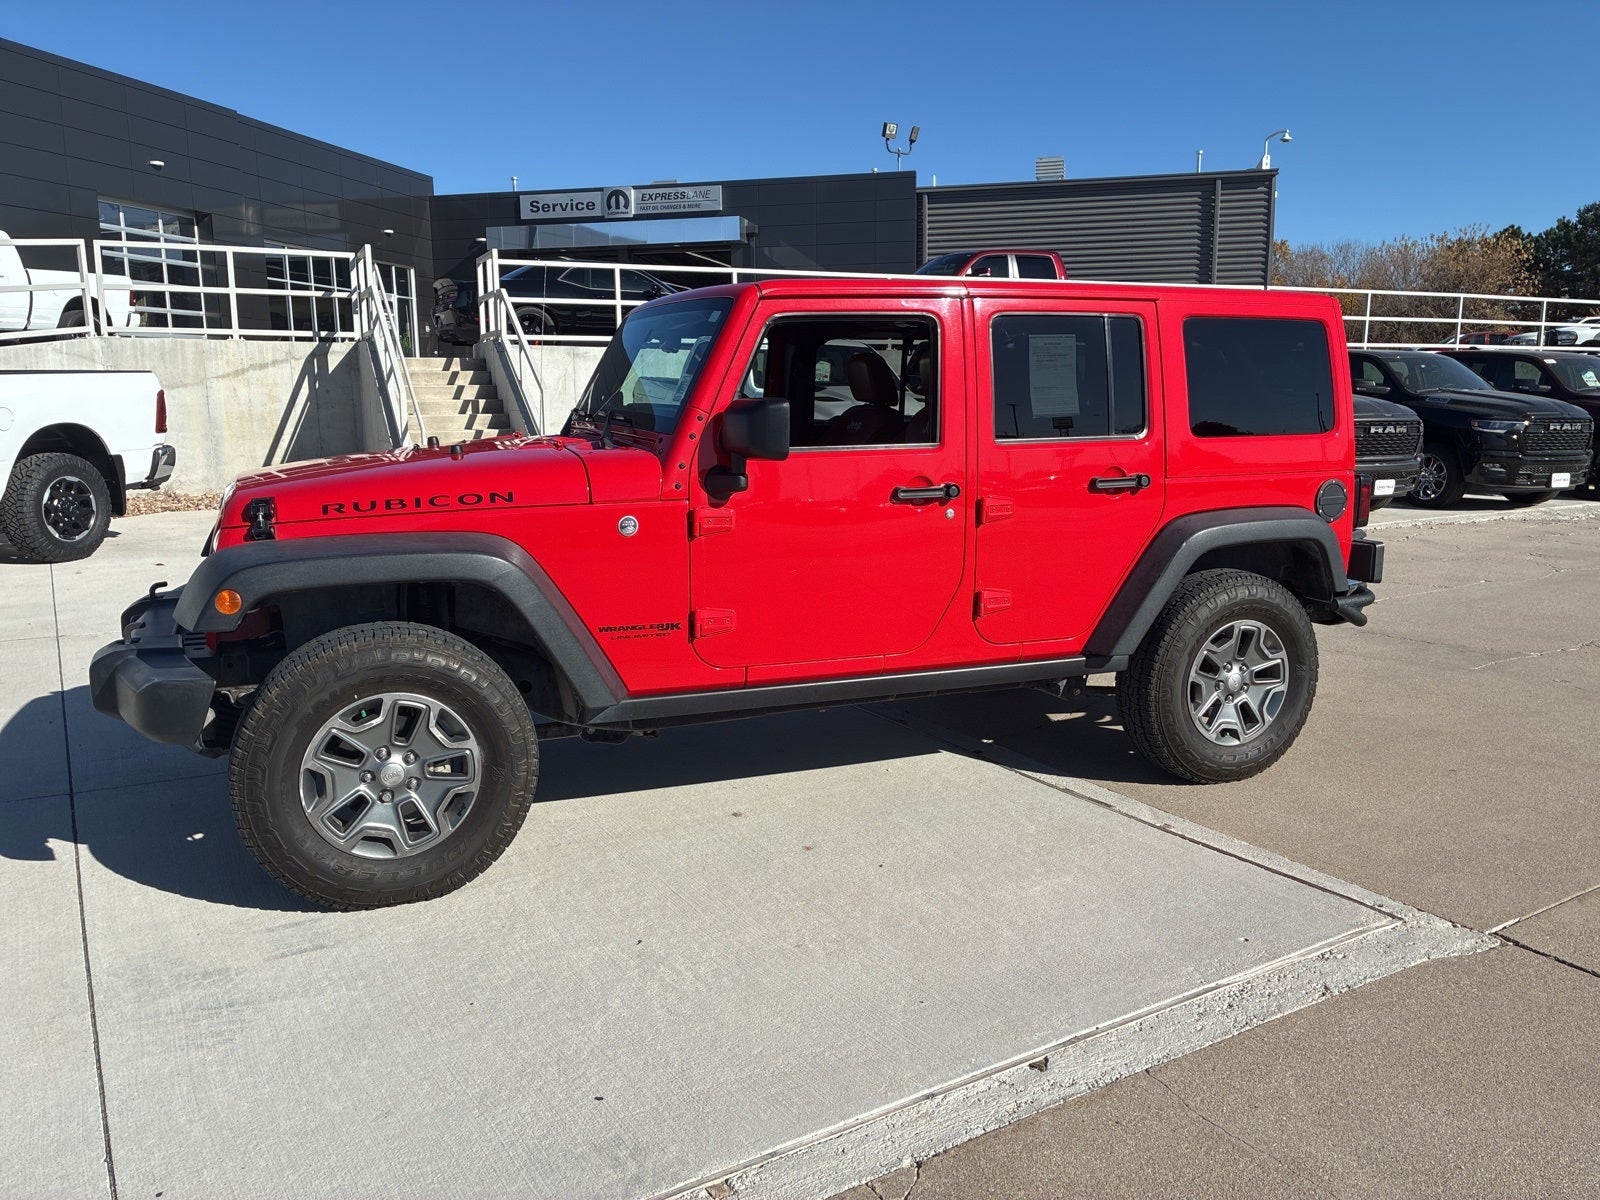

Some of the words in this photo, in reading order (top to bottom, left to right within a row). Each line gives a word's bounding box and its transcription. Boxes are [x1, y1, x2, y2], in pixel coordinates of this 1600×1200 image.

[529, 198, 596, 213] Service
[1370, 425, 1408, 434] RAM
[1549, 422, 1581, 431] RAM
[321, 491, 514, 516] RUBICON
[610, 632, 671, 641] UNLIMITED
